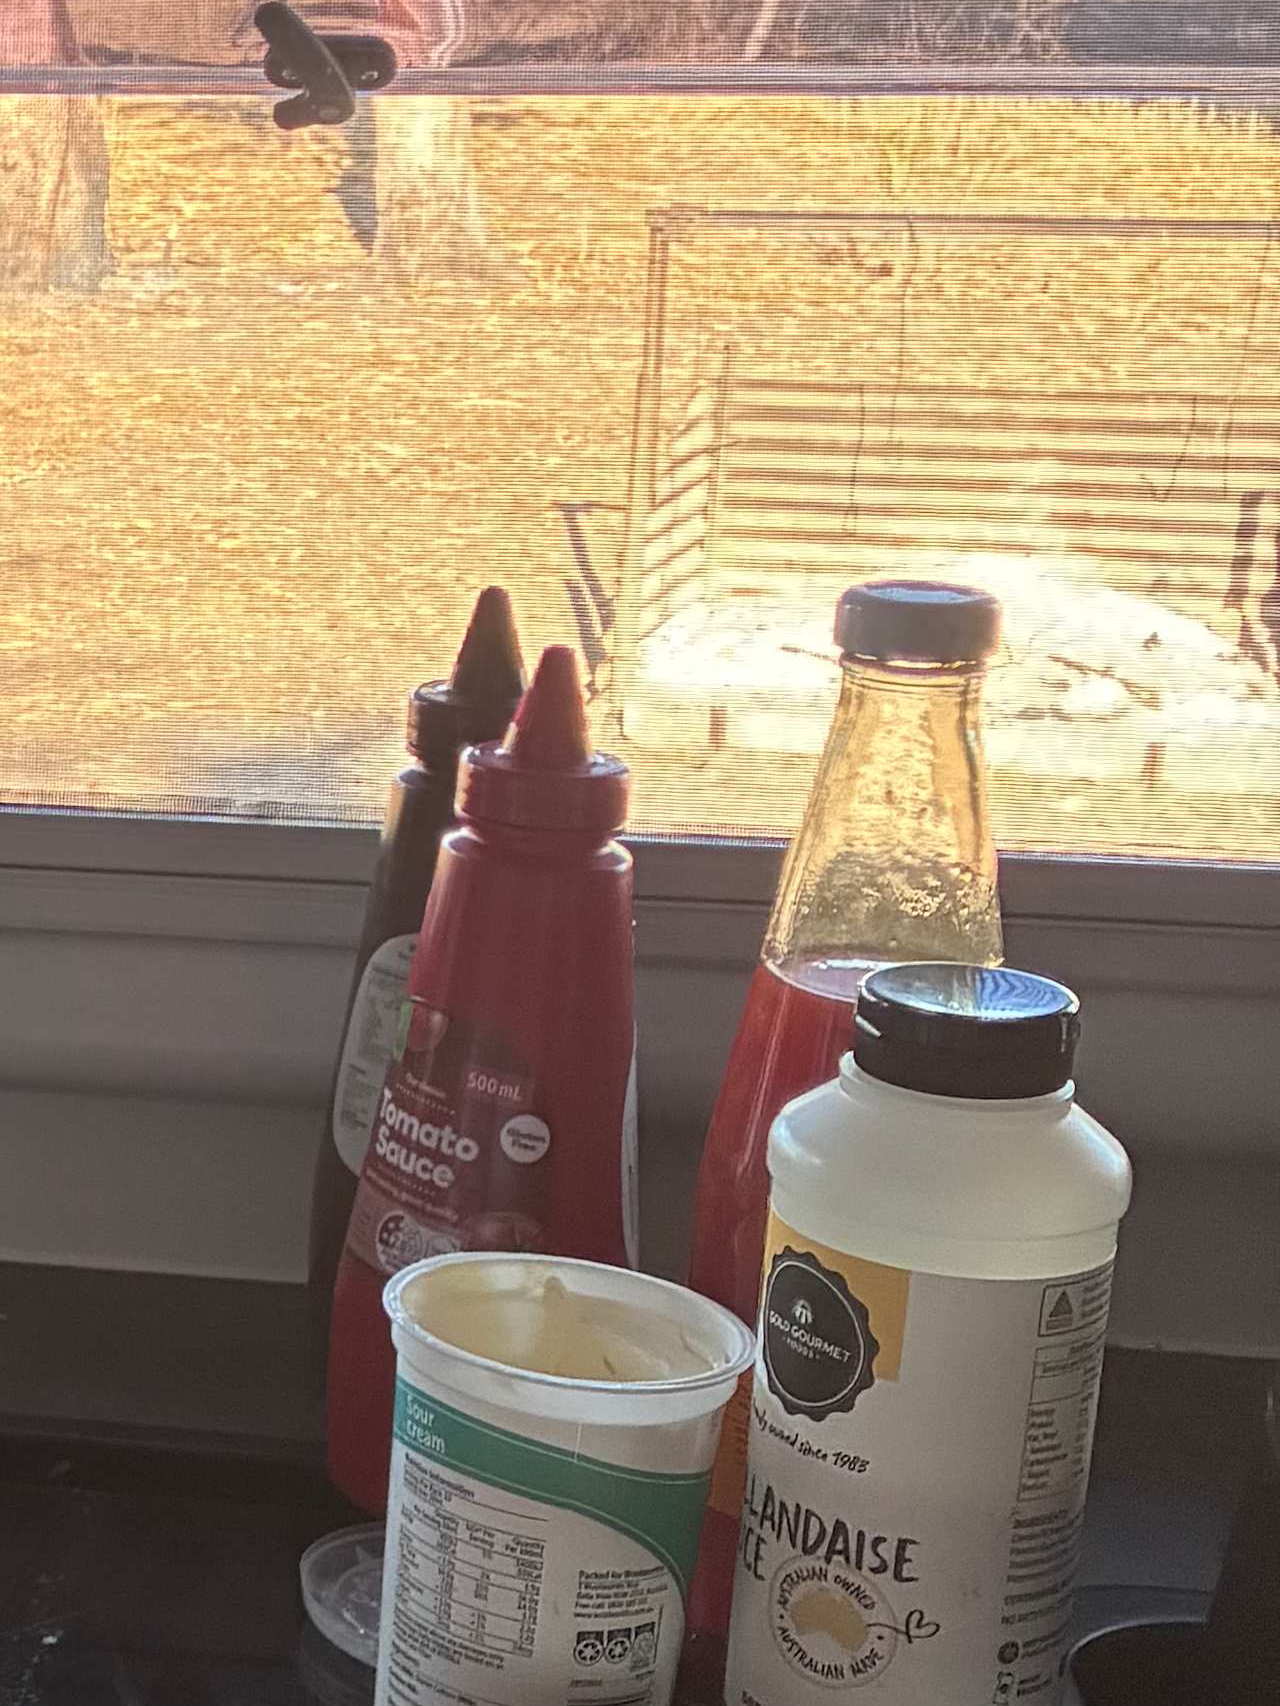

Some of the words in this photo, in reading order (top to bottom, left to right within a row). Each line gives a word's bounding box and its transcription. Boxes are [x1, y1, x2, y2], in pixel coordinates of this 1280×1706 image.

[379, 1086, 480, 1162] Tomato
[375, 1124, 456, 1188] Sauce
[791, 1325, 852, 1363] GOURMET
[406, 1394, 436, 1427] Sour
[406, 1420, 446, 1454] cream
[798, 1439, 829, 1462] since
[832, 1451, 871, 1474] 1983
[744, 1472, 922, 1583] LANDAISE
[834, 1573, 877, 1611] OWNED
[777, 1625, 846, 1681] AUSTRALIAN
